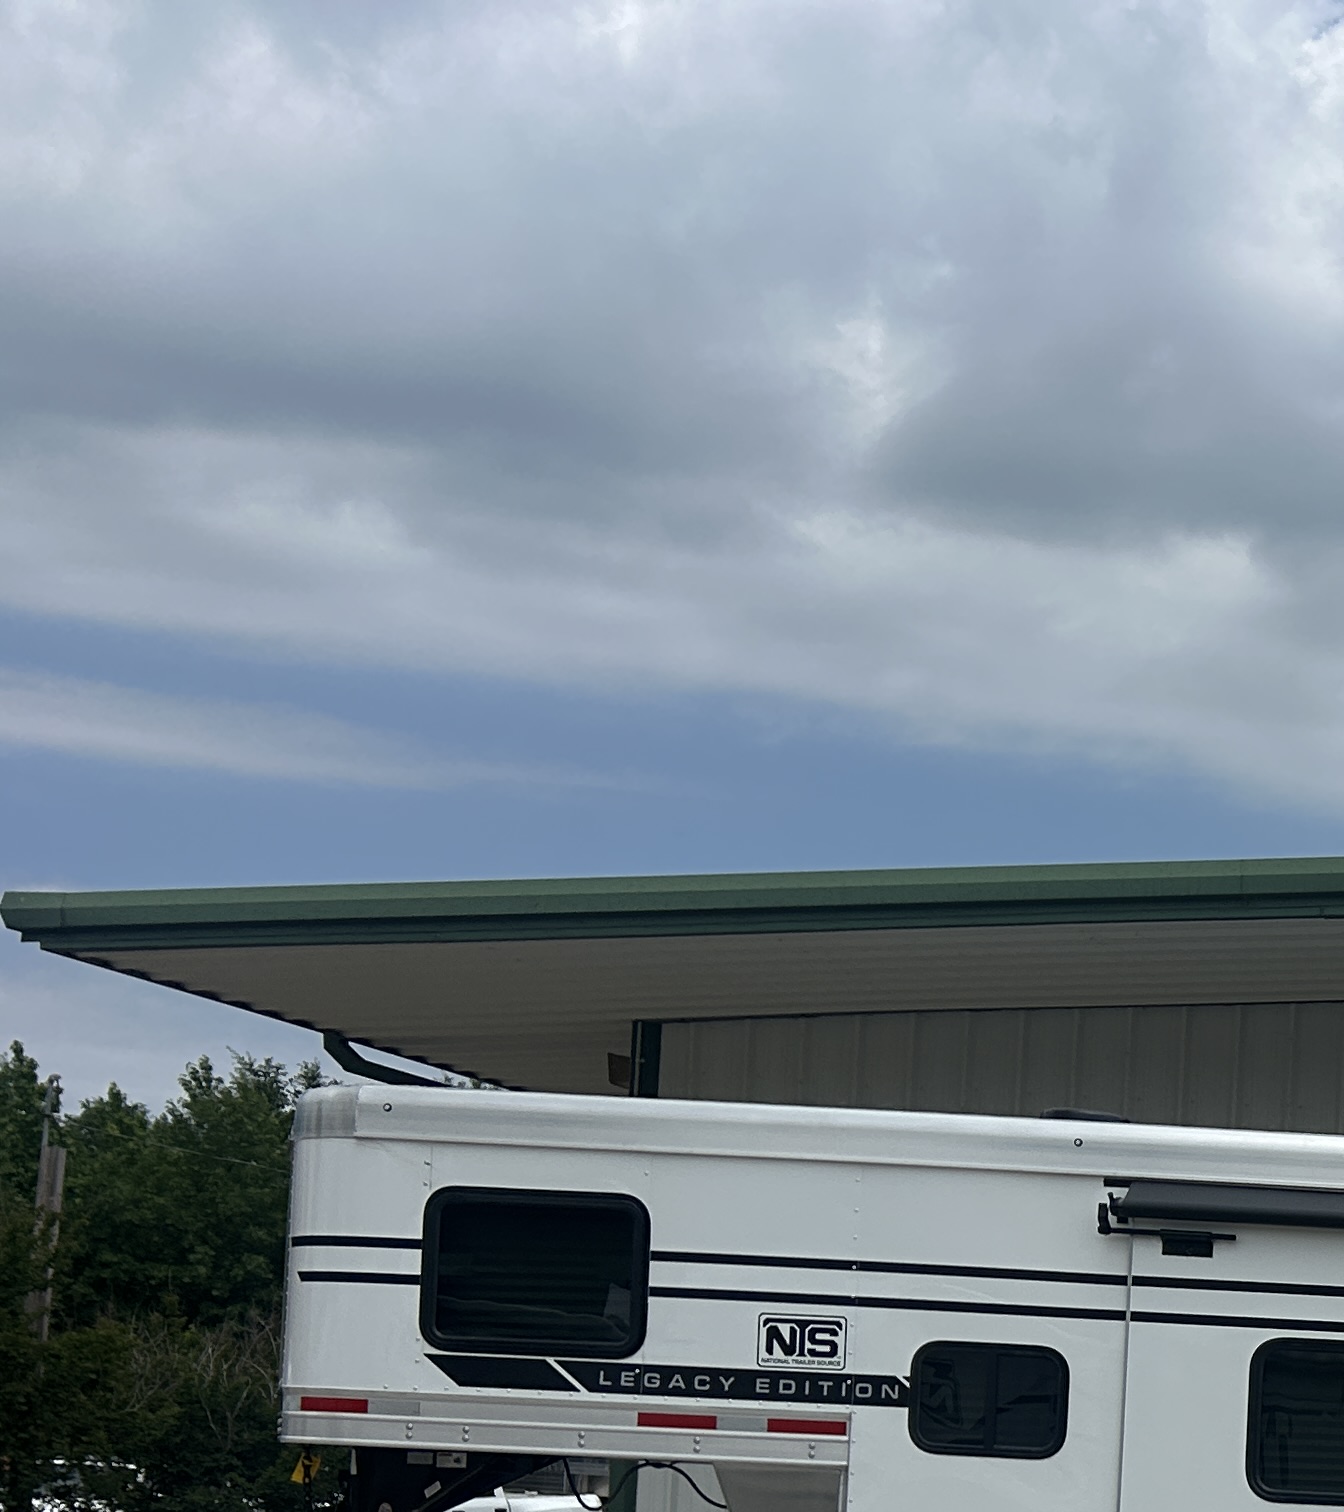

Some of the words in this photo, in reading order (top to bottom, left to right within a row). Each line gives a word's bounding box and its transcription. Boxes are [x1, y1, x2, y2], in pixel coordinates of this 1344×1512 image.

[763, 1317, 843, 1359] NTS
[599, 1369, 736, 1392] LEGACY
[755, 1377, 900, 1400] EDITION
